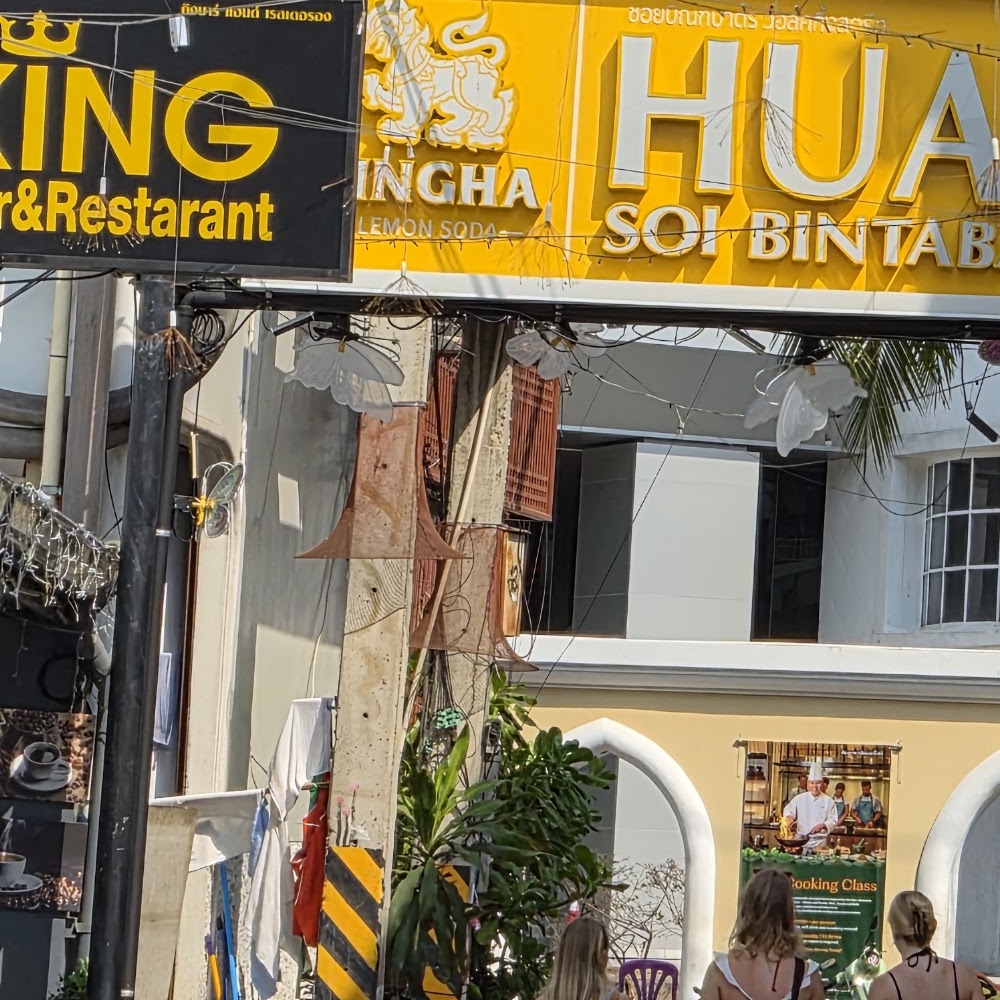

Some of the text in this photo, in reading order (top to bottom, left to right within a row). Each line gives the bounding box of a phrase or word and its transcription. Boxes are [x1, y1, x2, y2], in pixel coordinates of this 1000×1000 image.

[0, 64, 279, 181] ING
[357, 158, 543, 208] INGHA
[357, 216, 497, 239] LEMON SODA
[603, 202, 721, 257] SOI
[842, 878, 877, 892] Class
